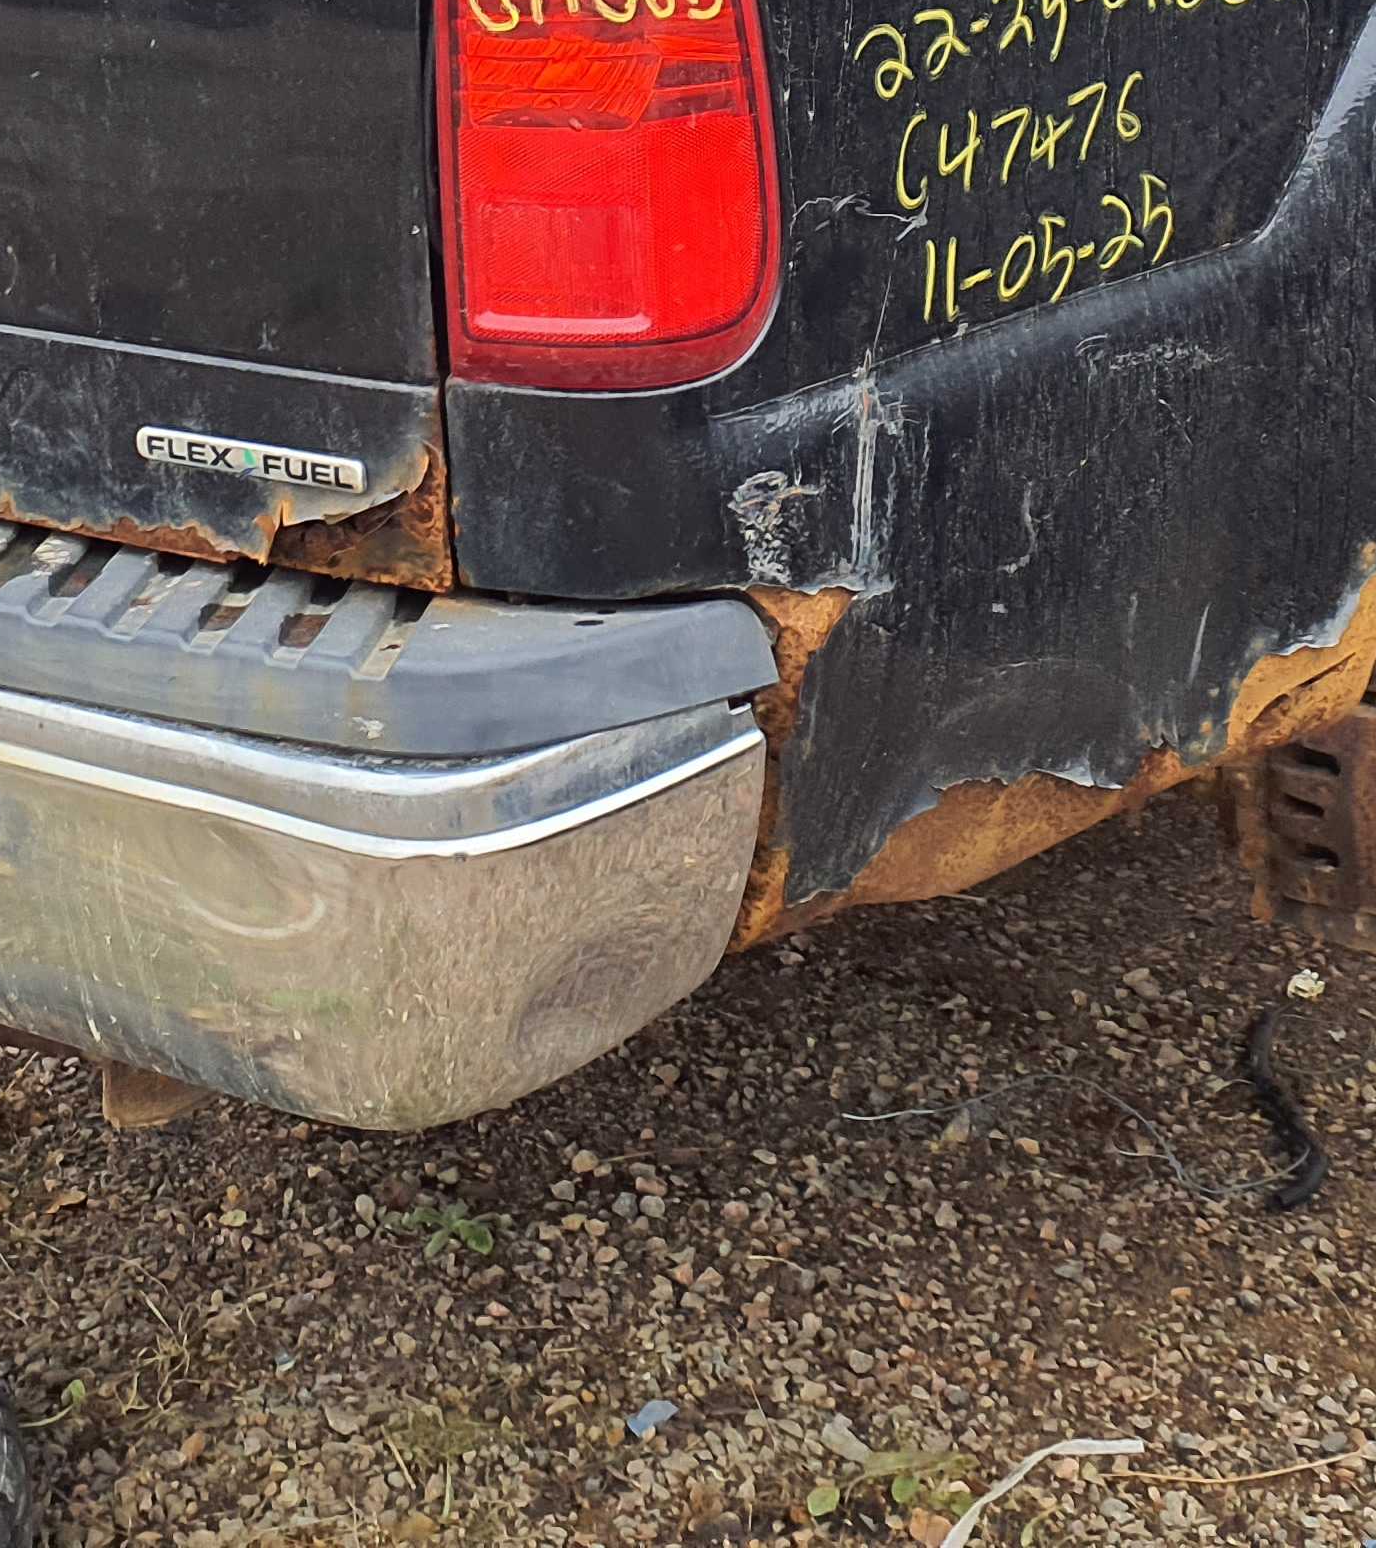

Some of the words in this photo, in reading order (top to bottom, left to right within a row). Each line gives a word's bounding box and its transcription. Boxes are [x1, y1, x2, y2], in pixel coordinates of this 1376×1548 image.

[923, 173, 1174, 322] 11-05-25
[145, 435, 234, 469] FLEX
[262, 454, 354, 490] FUEL
